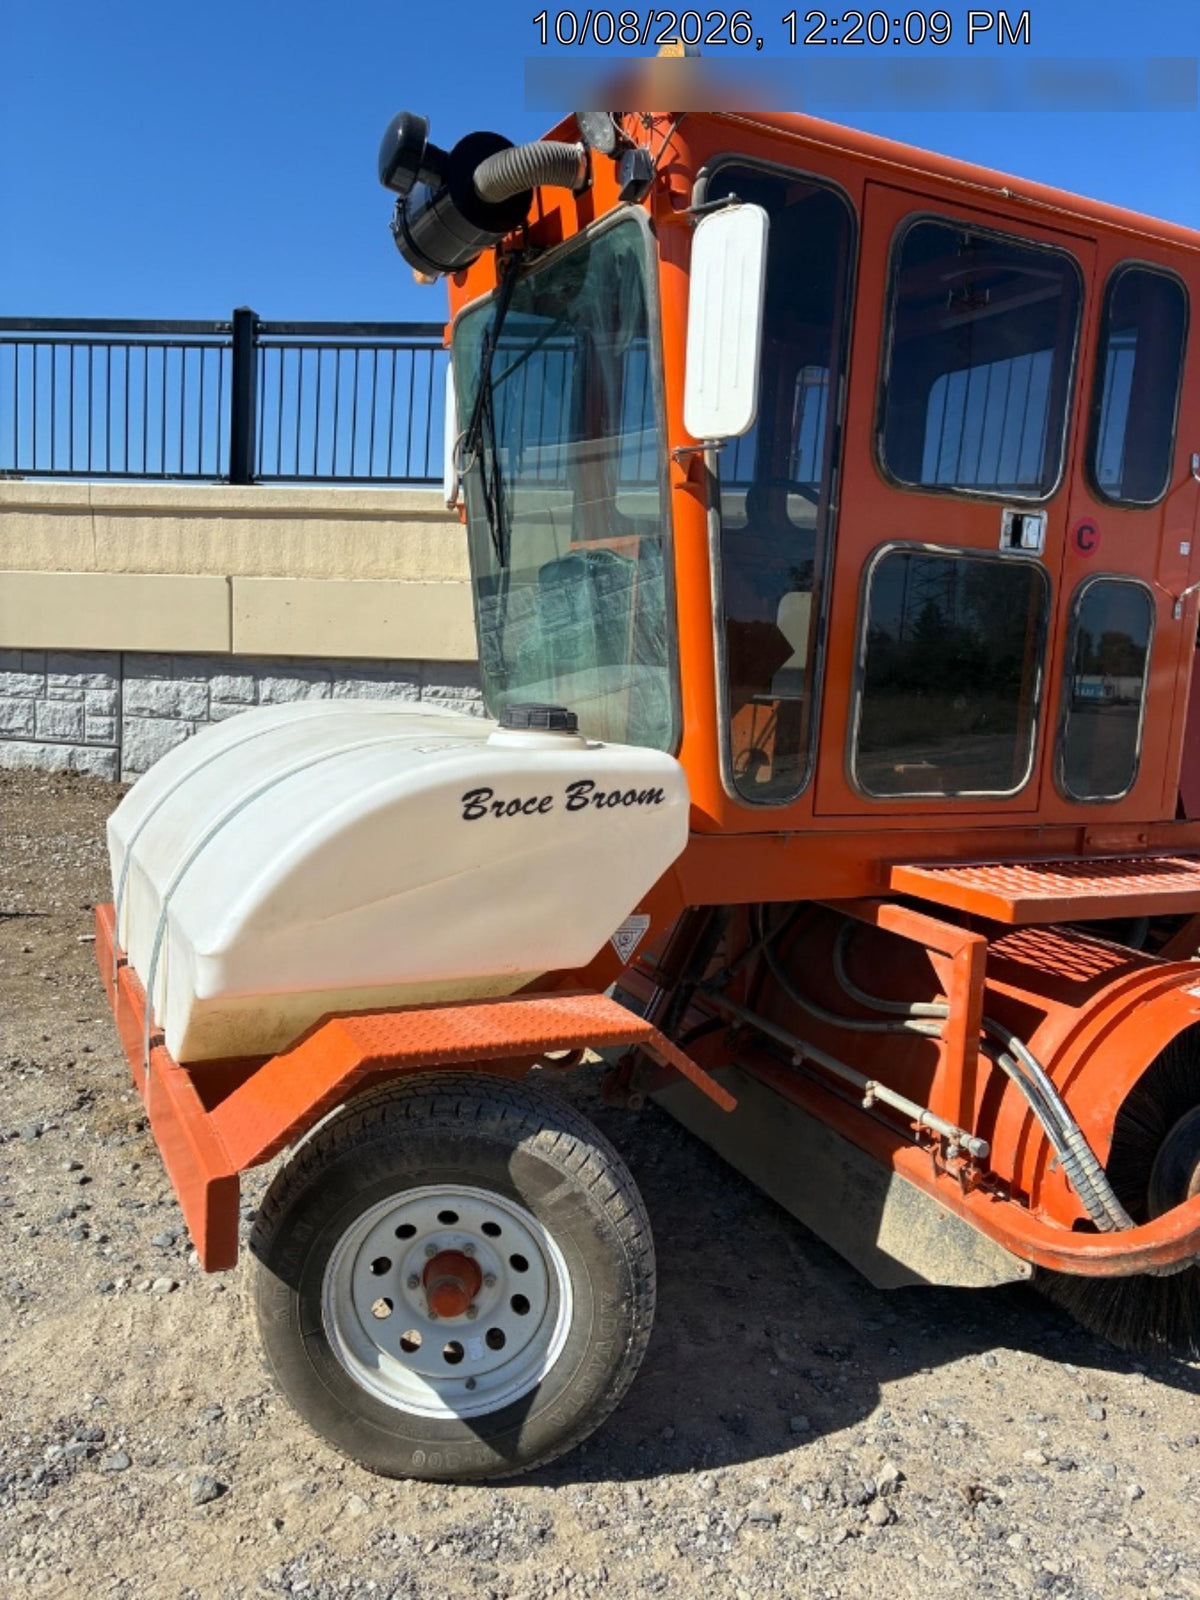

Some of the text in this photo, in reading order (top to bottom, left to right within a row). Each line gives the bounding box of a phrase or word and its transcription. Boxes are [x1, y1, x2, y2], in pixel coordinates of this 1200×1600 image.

[1076, 525, 1095, 550] C
[461, 779, 665, 821] Broce Broom
